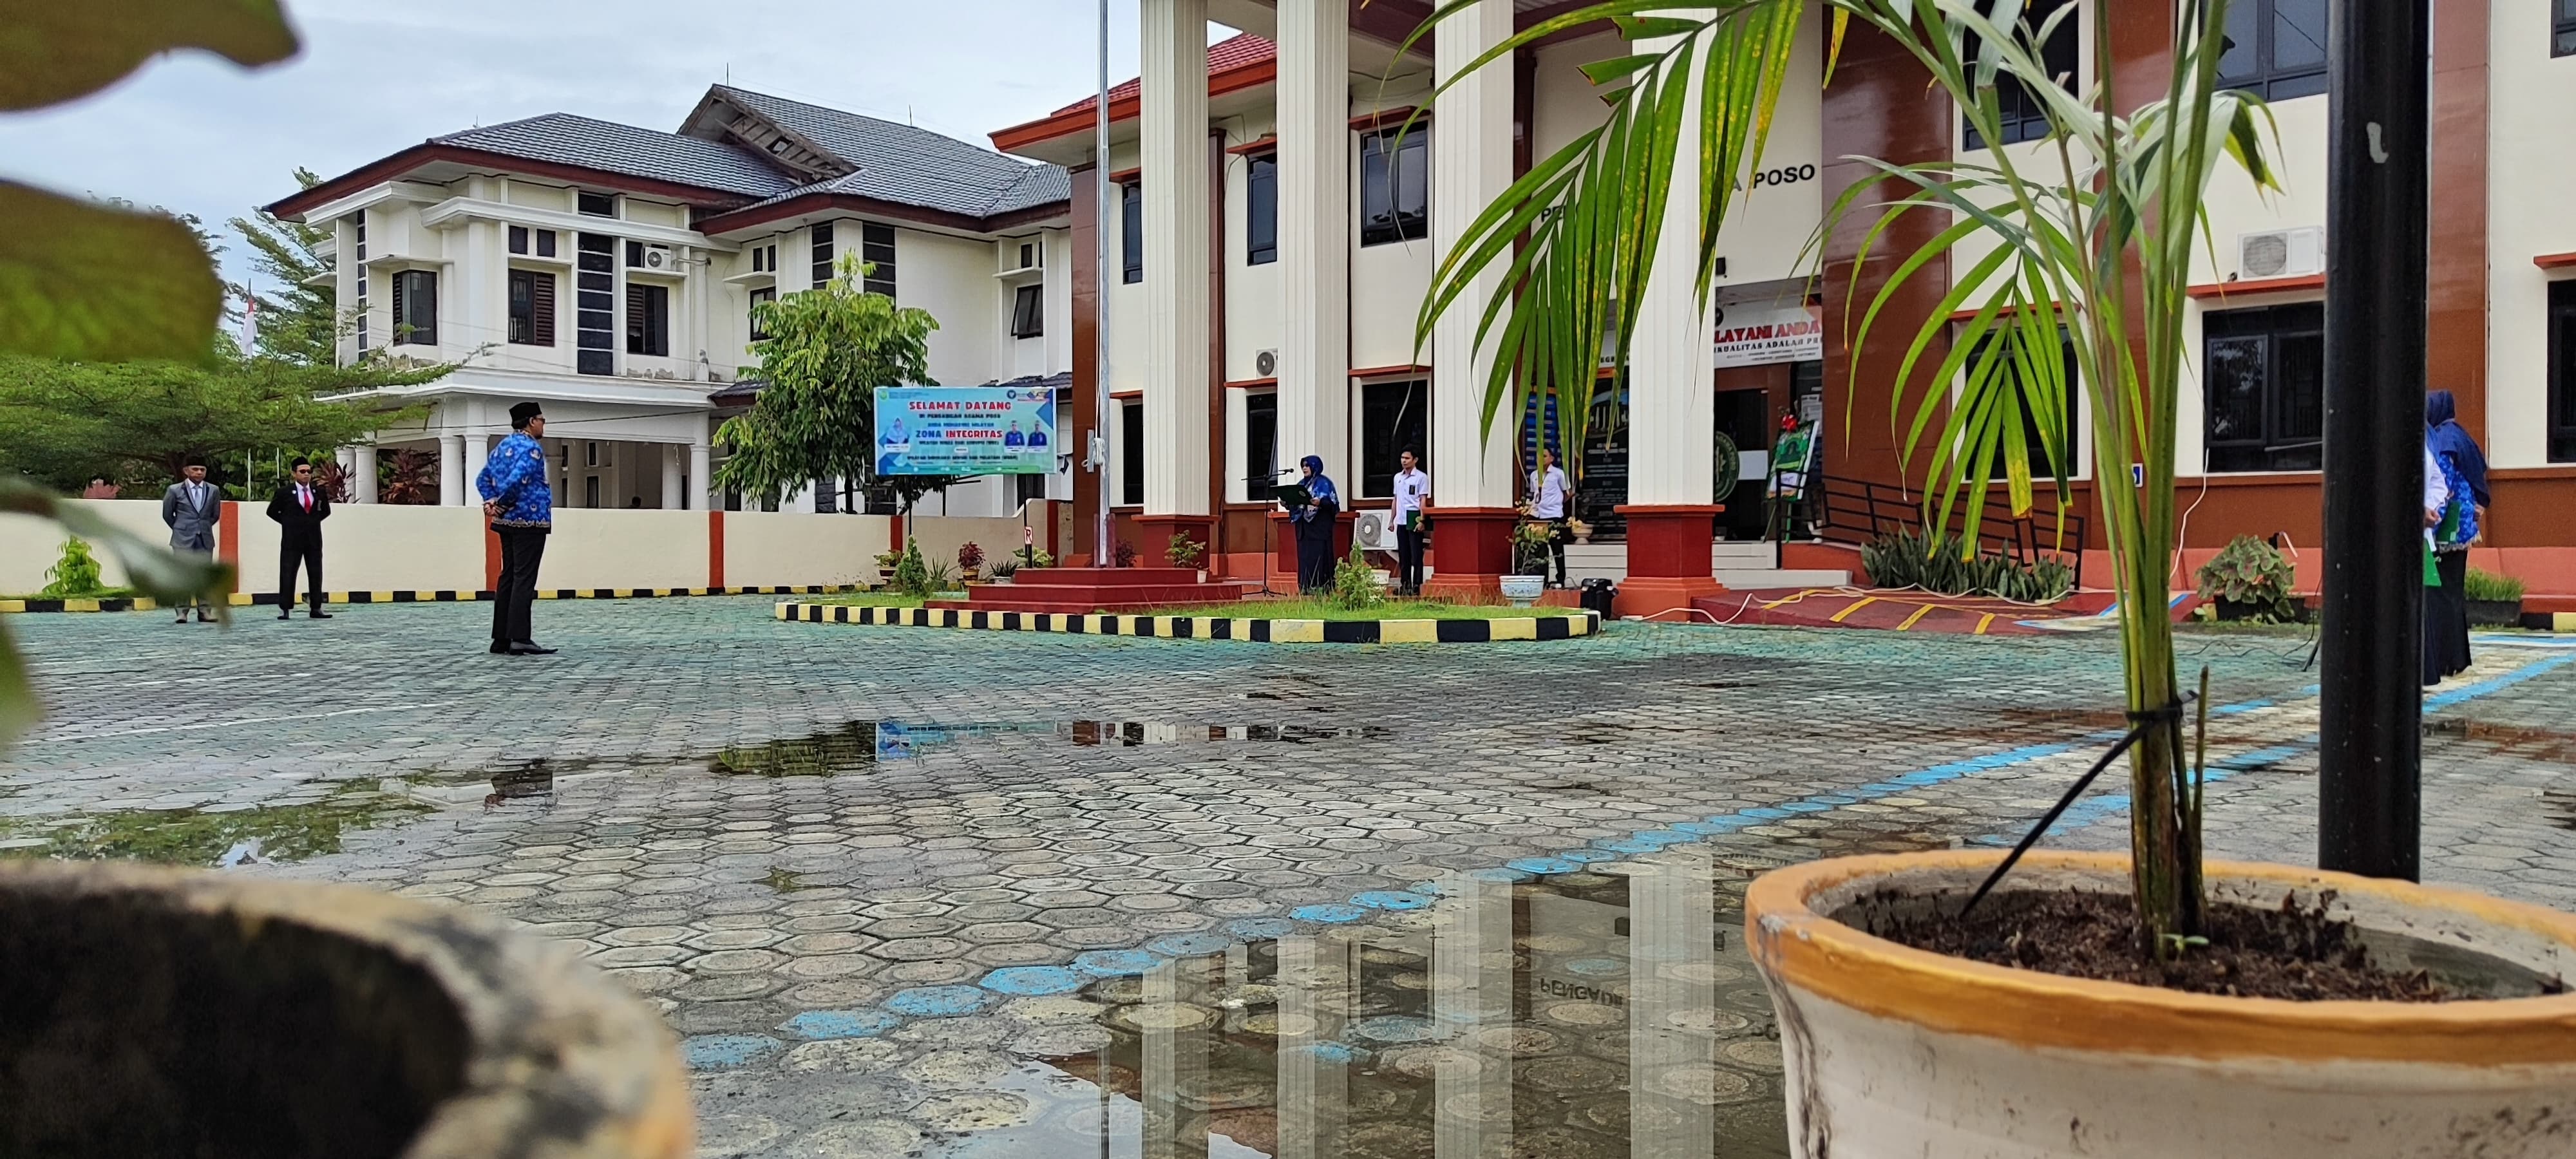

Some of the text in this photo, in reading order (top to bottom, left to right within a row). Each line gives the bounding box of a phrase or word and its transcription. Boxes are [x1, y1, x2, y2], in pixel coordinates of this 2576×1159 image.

[1752, 164, 1815, 189] POSO
[1775, 320, 1821, 338] ANDA
[1765, 339, 1803, 348] ADALAH
[909, 401, 1012, 410] SELAMAT DATANG
